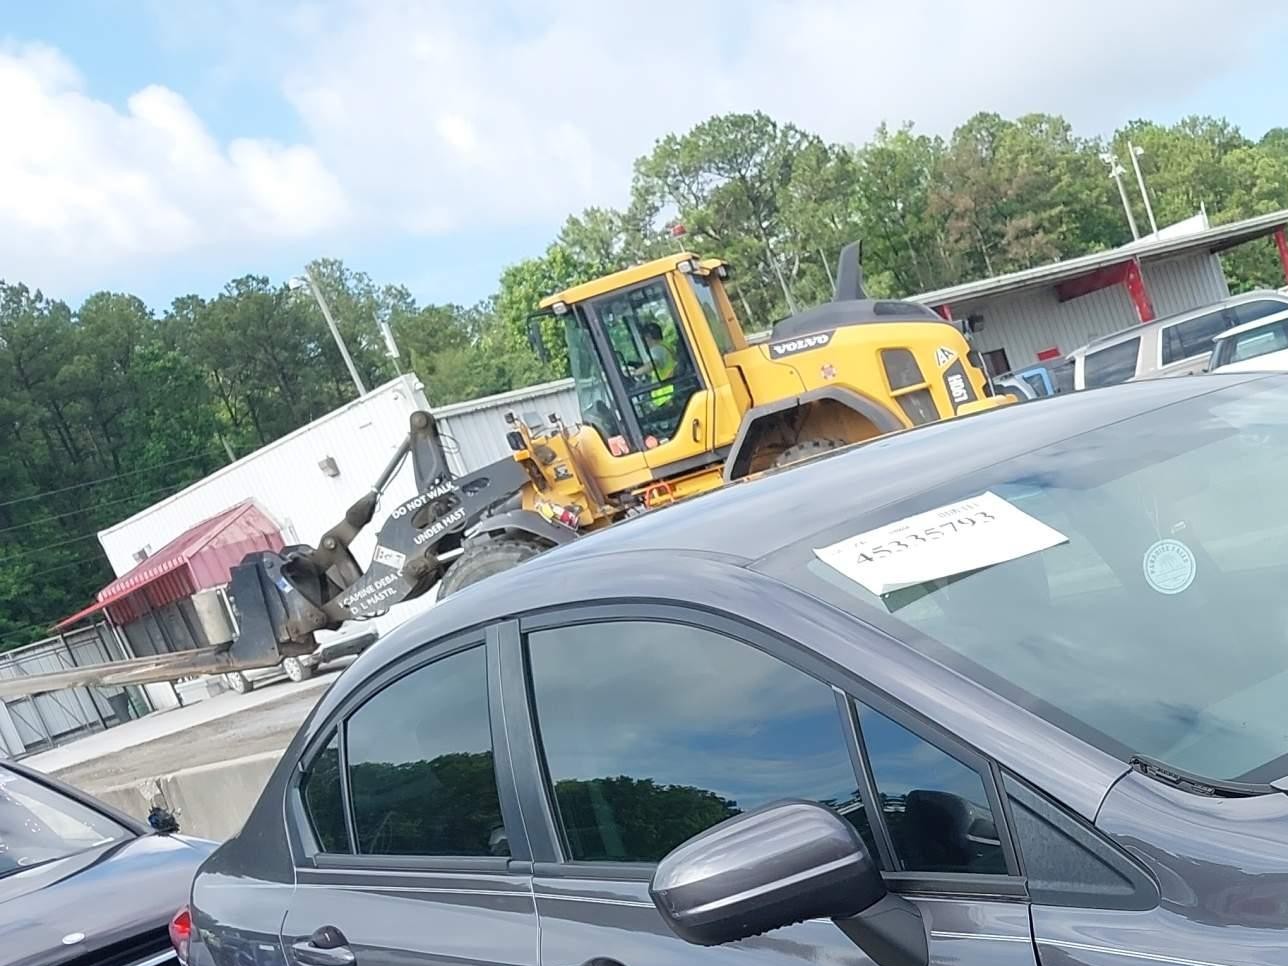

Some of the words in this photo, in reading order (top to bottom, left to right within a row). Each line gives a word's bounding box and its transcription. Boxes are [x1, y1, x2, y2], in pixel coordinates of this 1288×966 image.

[773, 334, 829, 354] VOLVO
[391, 507, 408, 520] DO
[406, 494, 428, 512] NOT
[426, 481, 456, 501] WALK
[413, 523, 444, 545] UNDER
[443, 507, 467, 529] MAST
[855, 510, 999, 567] 45335793
[343, 583, 378, 607] CAMINE
[350, 599, 369, 616] DL
